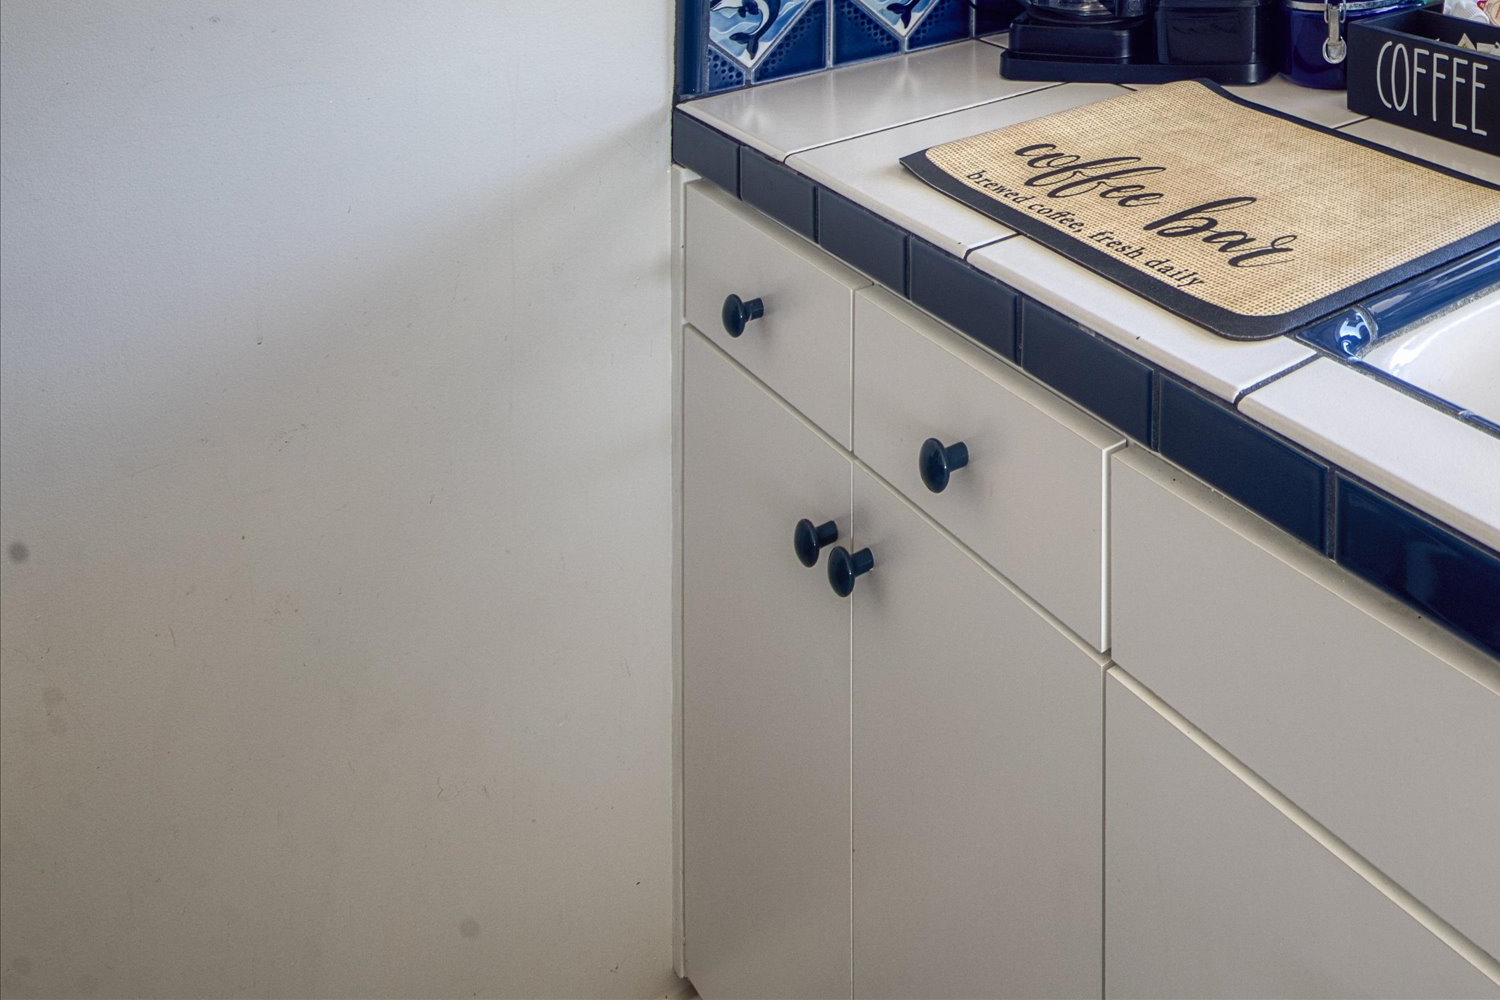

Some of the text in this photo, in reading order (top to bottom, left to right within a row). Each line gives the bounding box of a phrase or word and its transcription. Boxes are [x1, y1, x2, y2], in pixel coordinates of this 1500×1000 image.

[1376, 40, 1488, 136] COFFEE
[966, 170, 1205, 288] brewed coffee, fresh daily
[1014, 143, 1298, 268] coffee bar
